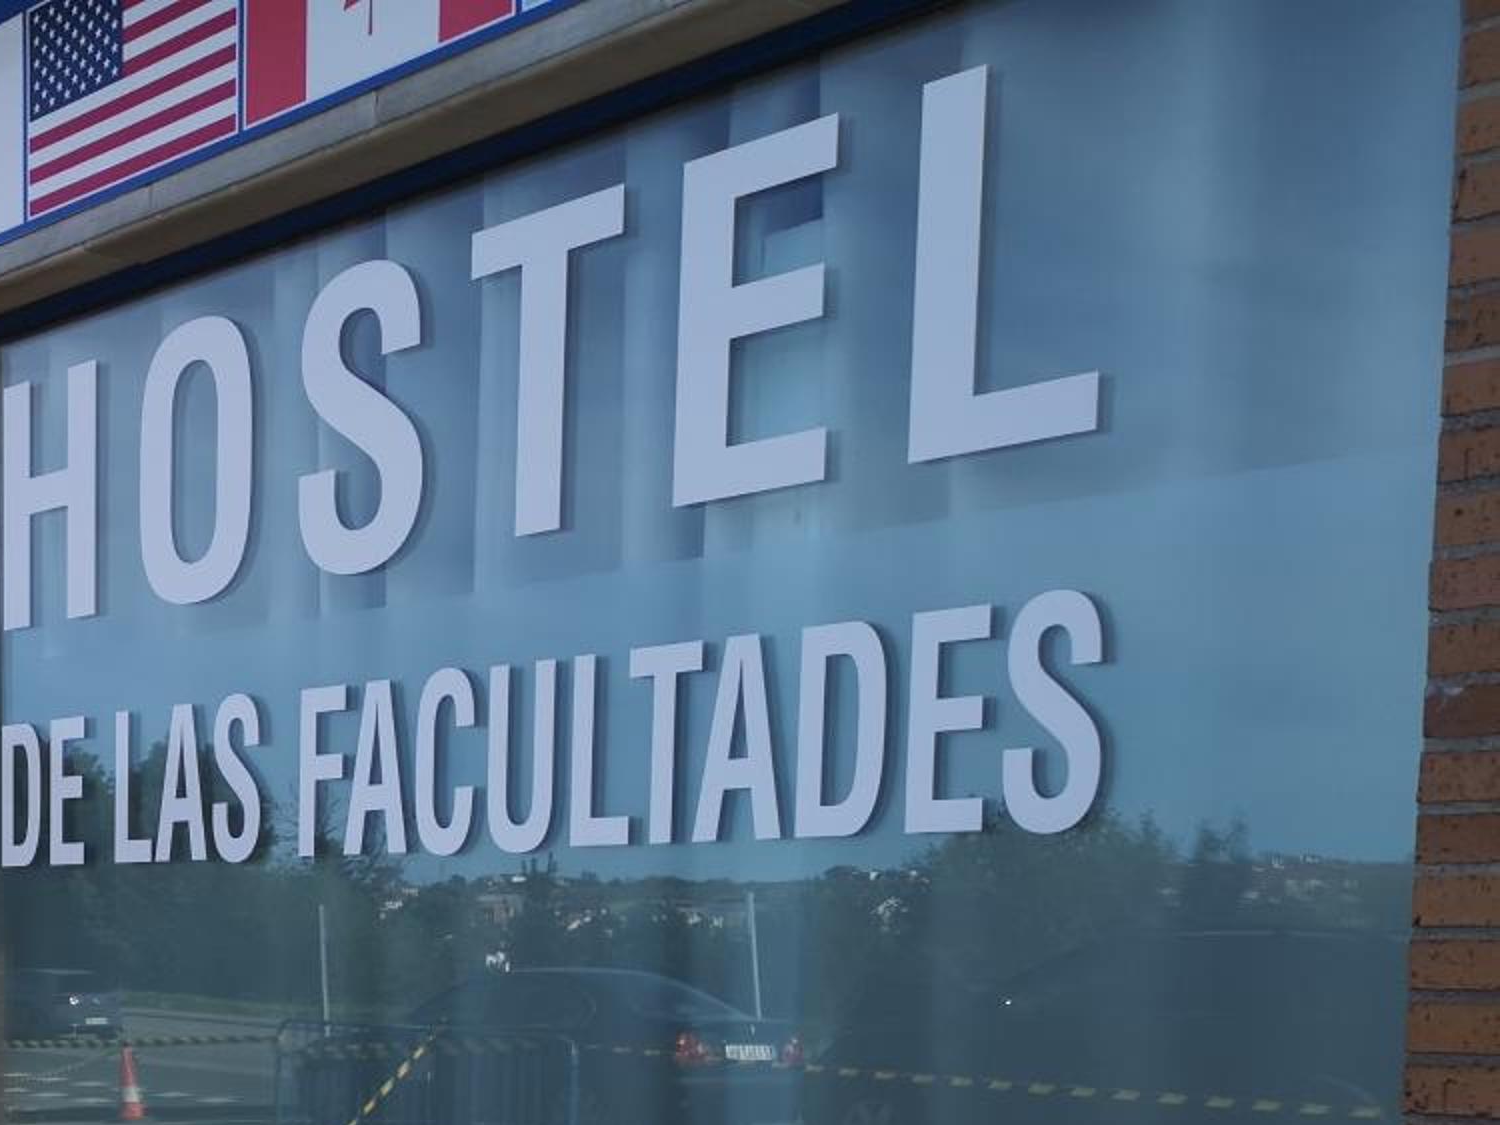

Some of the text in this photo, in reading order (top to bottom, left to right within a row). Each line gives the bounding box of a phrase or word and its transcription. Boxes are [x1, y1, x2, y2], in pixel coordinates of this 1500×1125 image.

[3, 65, 1099, 631] HOSTEL
[1, 589, 1102, 867] DE LAS FACULTADES
